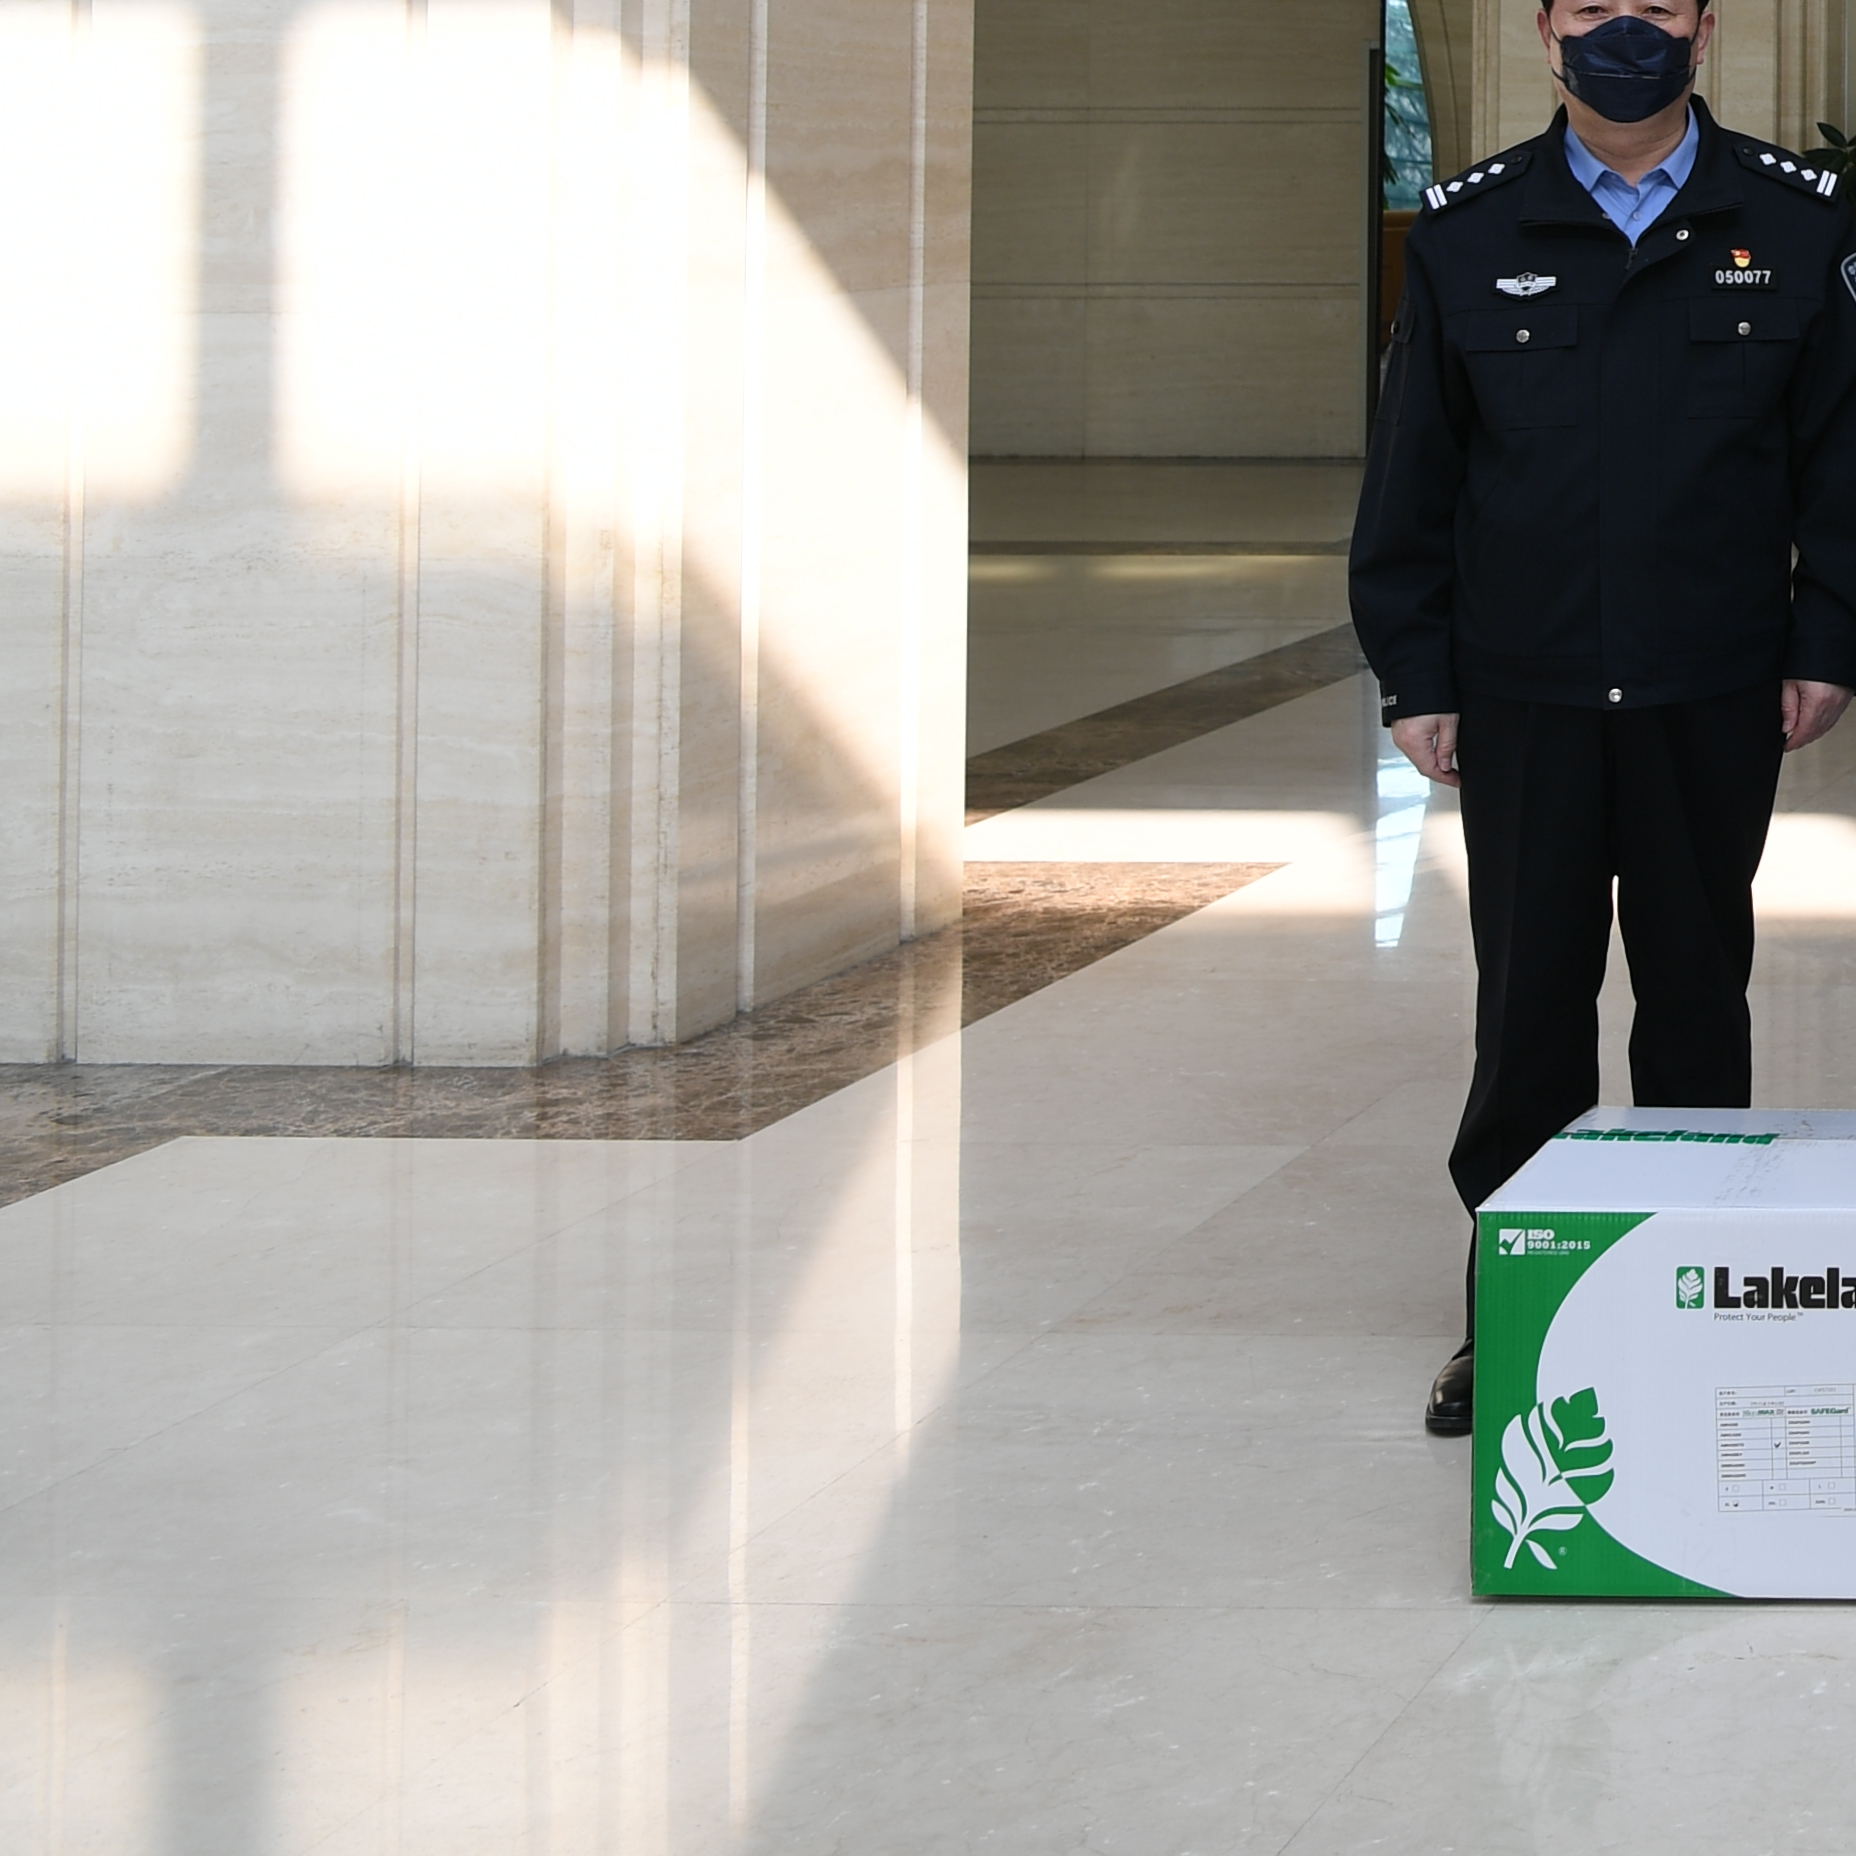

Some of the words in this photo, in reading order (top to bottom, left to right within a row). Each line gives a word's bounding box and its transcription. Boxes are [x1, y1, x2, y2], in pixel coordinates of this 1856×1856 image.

[1715, 270, 1771, 284] 050077
[1527, 1229, 1555, 1240] ISO
[1527, 1240, 1591, 1250] 9001:2015
[1714, 1313, 1743, 1321] Protect
[1746, 1313, 1765, 1321] Your
